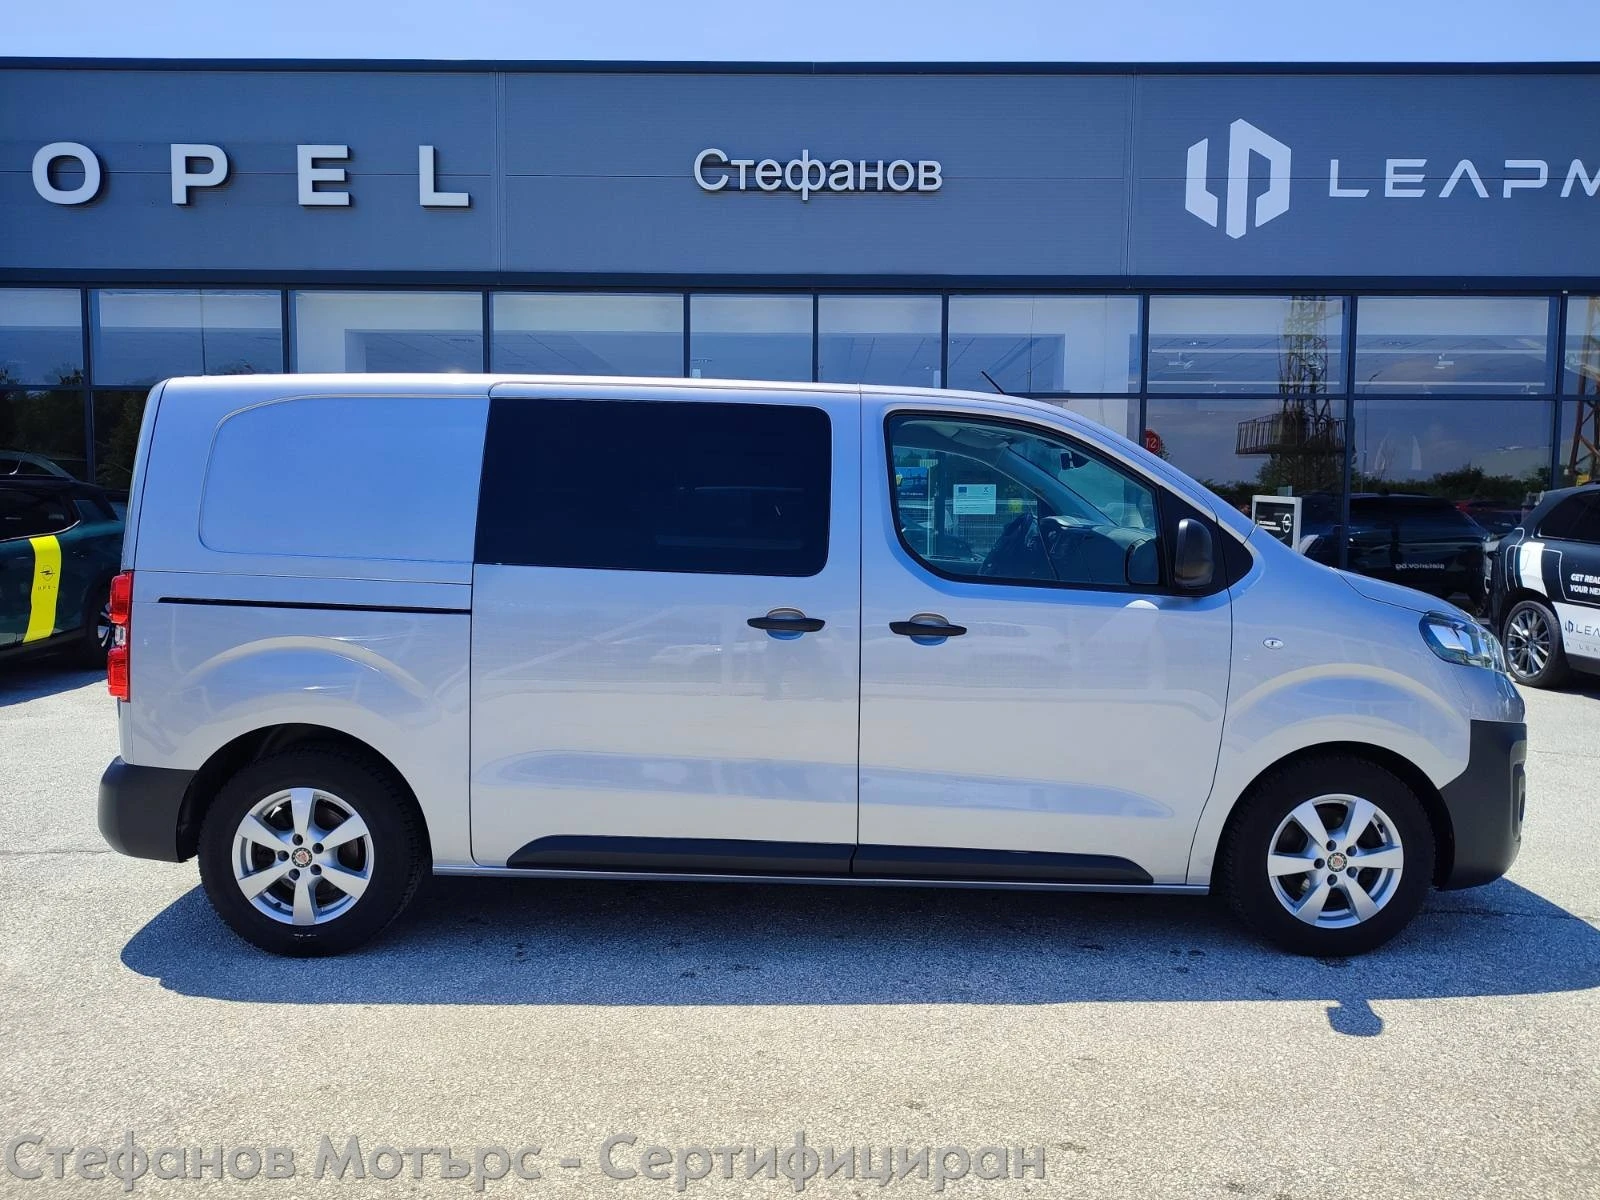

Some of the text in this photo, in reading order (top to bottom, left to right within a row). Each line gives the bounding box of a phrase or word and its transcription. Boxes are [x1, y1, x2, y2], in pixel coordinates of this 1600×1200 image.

[31, 141, 470, 207] OPEL
[693, 147, 943, 201] Стефанов
[1570, 573, 1584, 582] GET
[1570, 584, 1588, 594] YOUR
